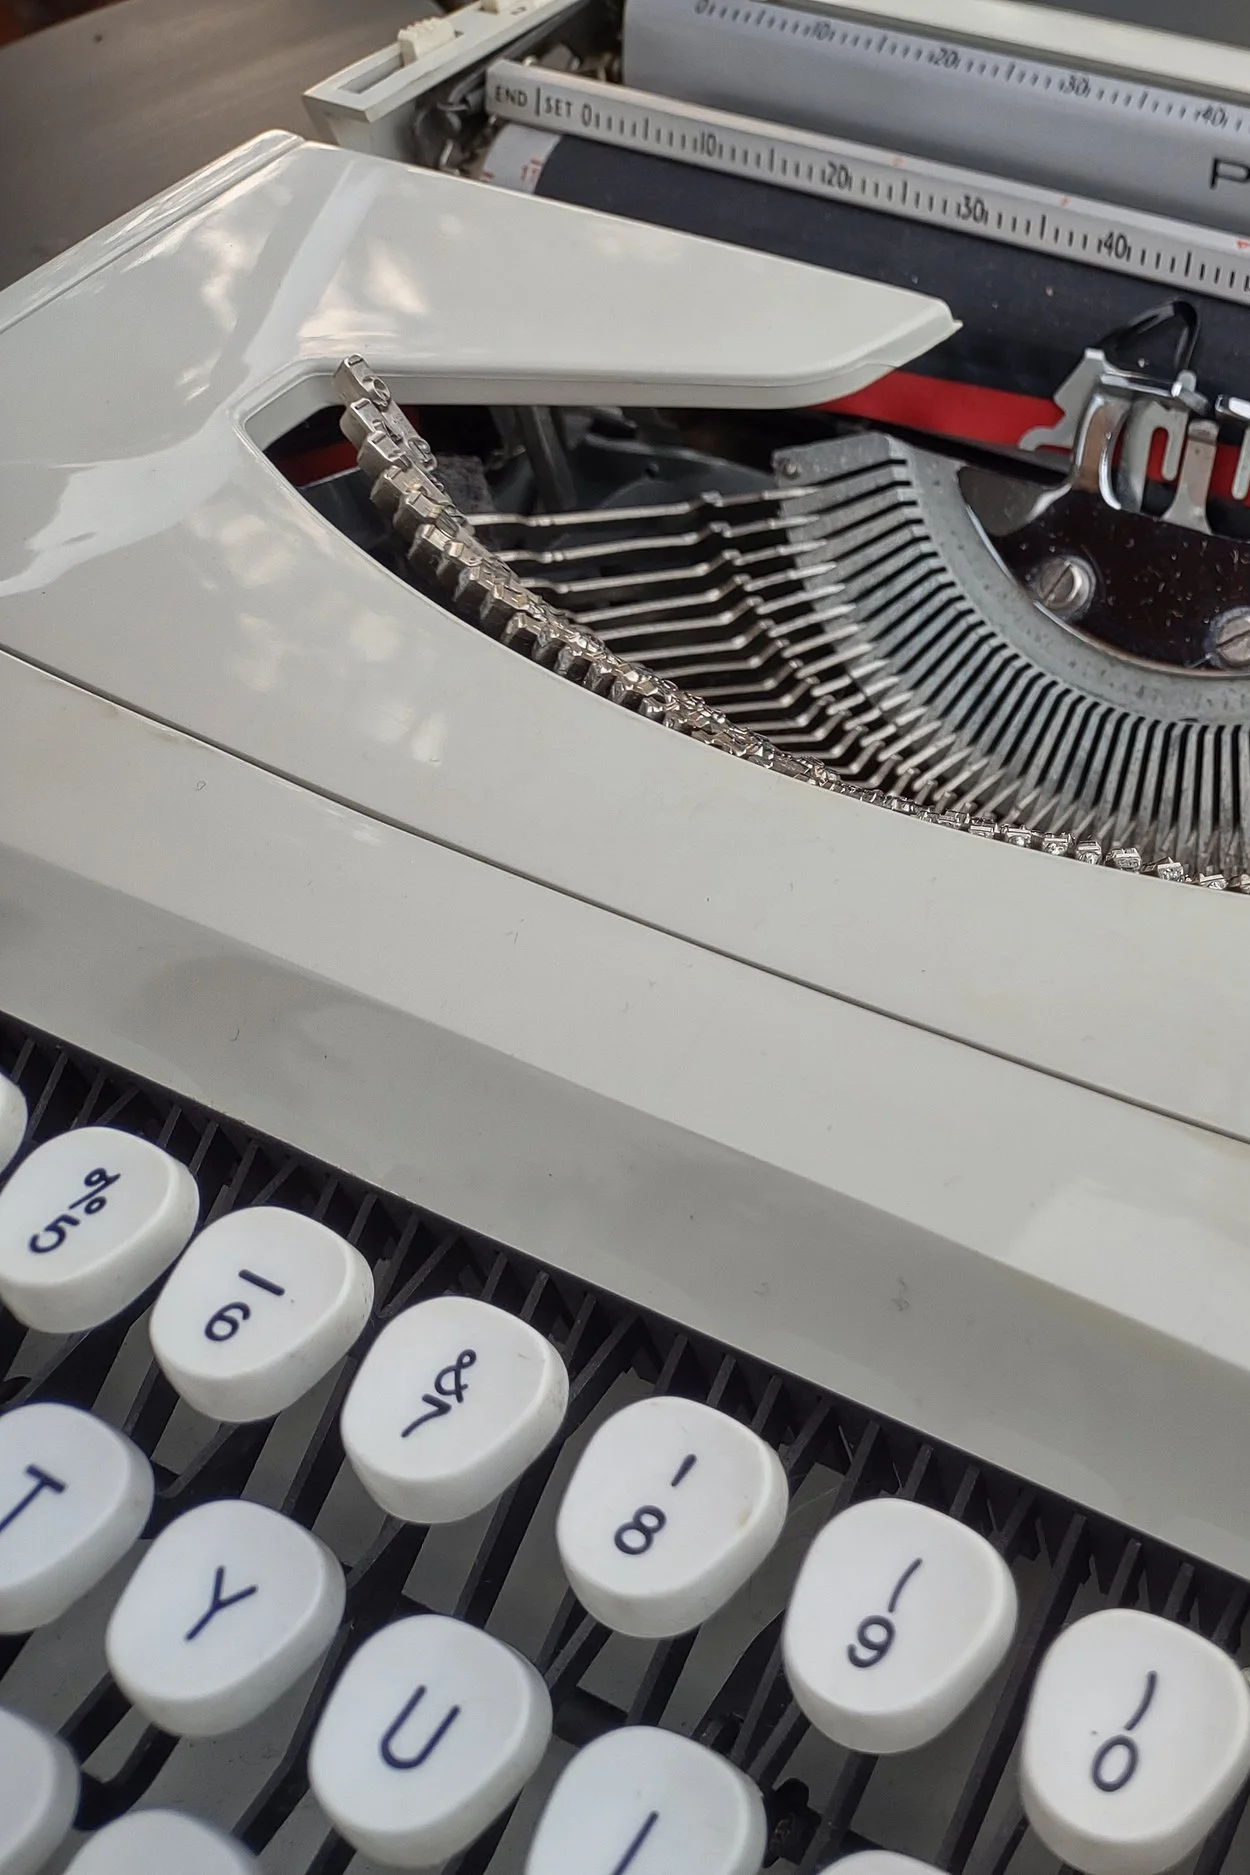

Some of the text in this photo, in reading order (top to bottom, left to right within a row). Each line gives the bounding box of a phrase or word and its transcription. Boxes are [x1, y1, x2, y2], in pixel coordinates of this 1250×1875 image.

[814, 21, 829, 41] 10
[935, 48, 957, 69] 20
[1066, 74, 1087, 97] 30
[1202, 104, 1225, 127] 40
[495, 86, 527, 106] END
[545, 97, 572, 118] SET
[581, 103, 593, 127] 0
[700, 131, 717, 154] 10
[826, 161, 851, 189] 20
[960, 193, 985, 223] 30
[1102, 231, 1129, 260] 40
[68, 1166, 121, 1215] %
[29, 1213, 81, 1254] 5
[204, 1301, 251, 1342] 6
[435, 1348, 478, 1403] &
[400, 1393, 452, 1438] 7
[614, 1503, 666, 1556] 8
[183, 1564, 259, 1643] Y
[846, 1614, 896, 1669] 9
[378, 1684, 462, 1771] U
[1091, 1732, 1139, 1794] 0
